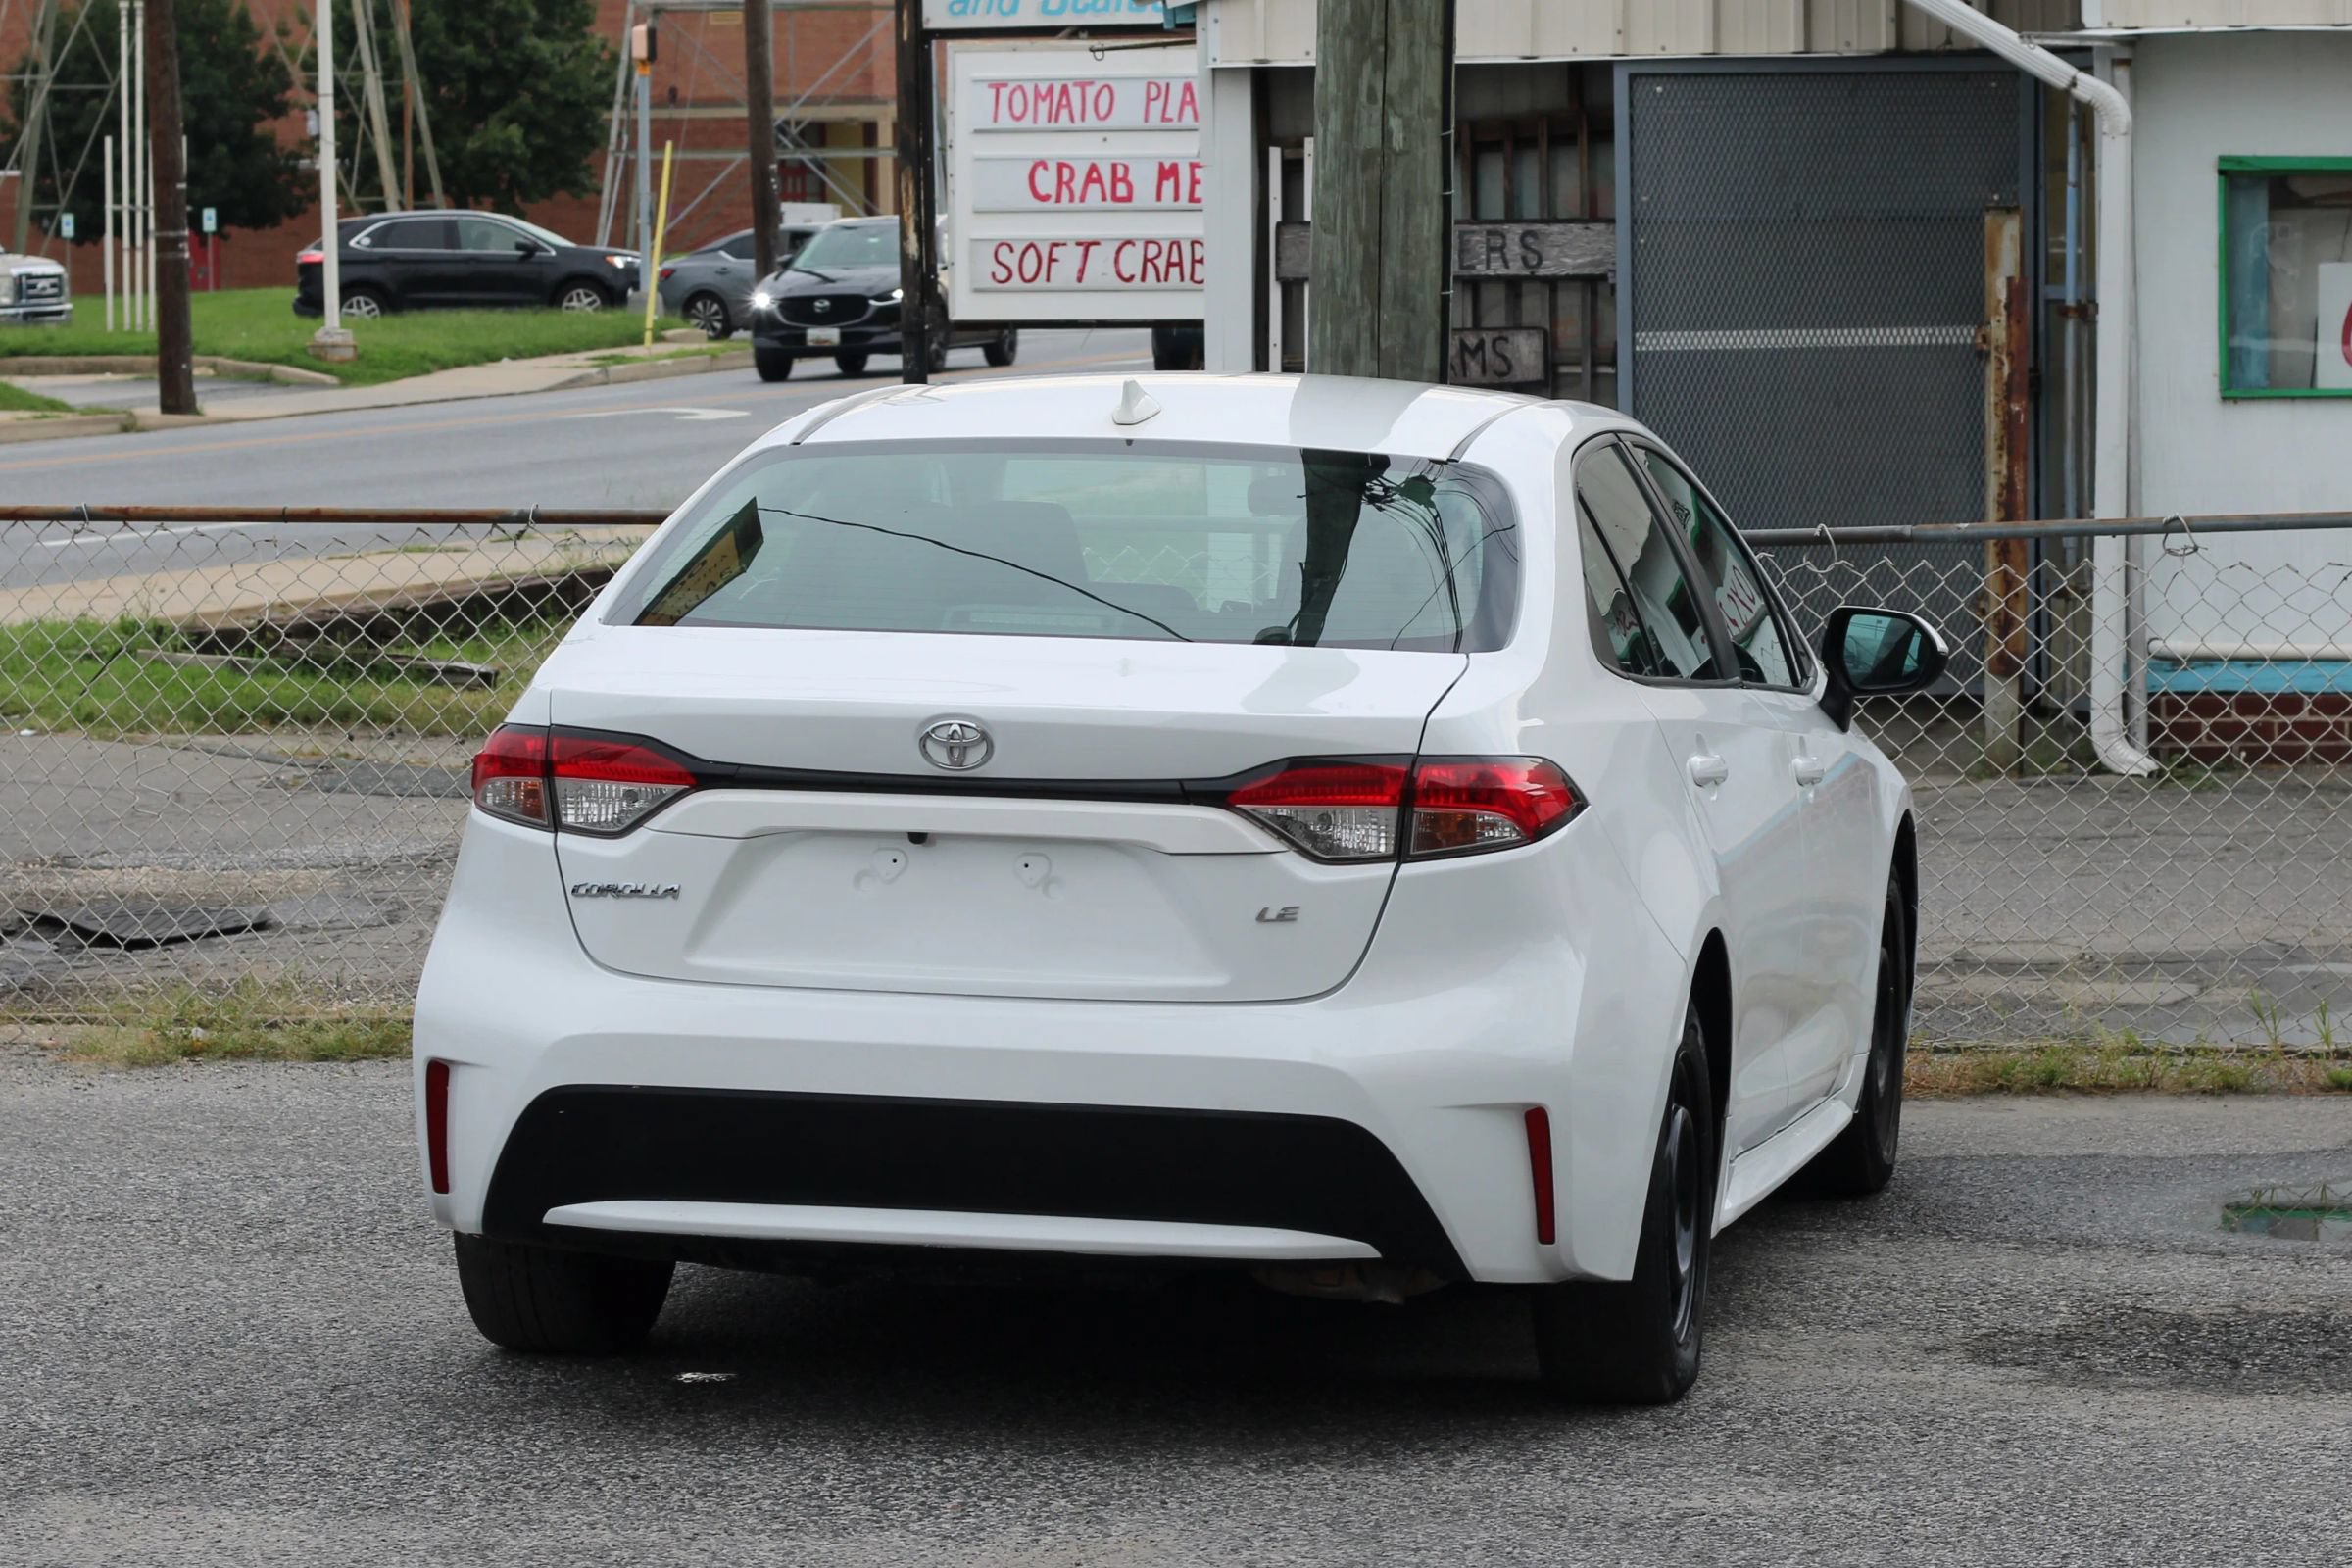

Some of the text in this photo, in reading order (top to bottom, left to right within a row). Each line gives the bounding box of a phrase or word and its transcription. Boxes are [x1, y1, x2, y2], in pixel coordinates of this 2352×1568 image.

[988, 80, 1200, 124] TOMATO PLA
[1028, 159, 1202, 204] CRAB ME
[991, 241, 1101, 284] SOFT
[1452, 336, 1513, 378] MS
[571, 882, 681, 901] COROLLA
[1255, 906, 1300, 923] LE
